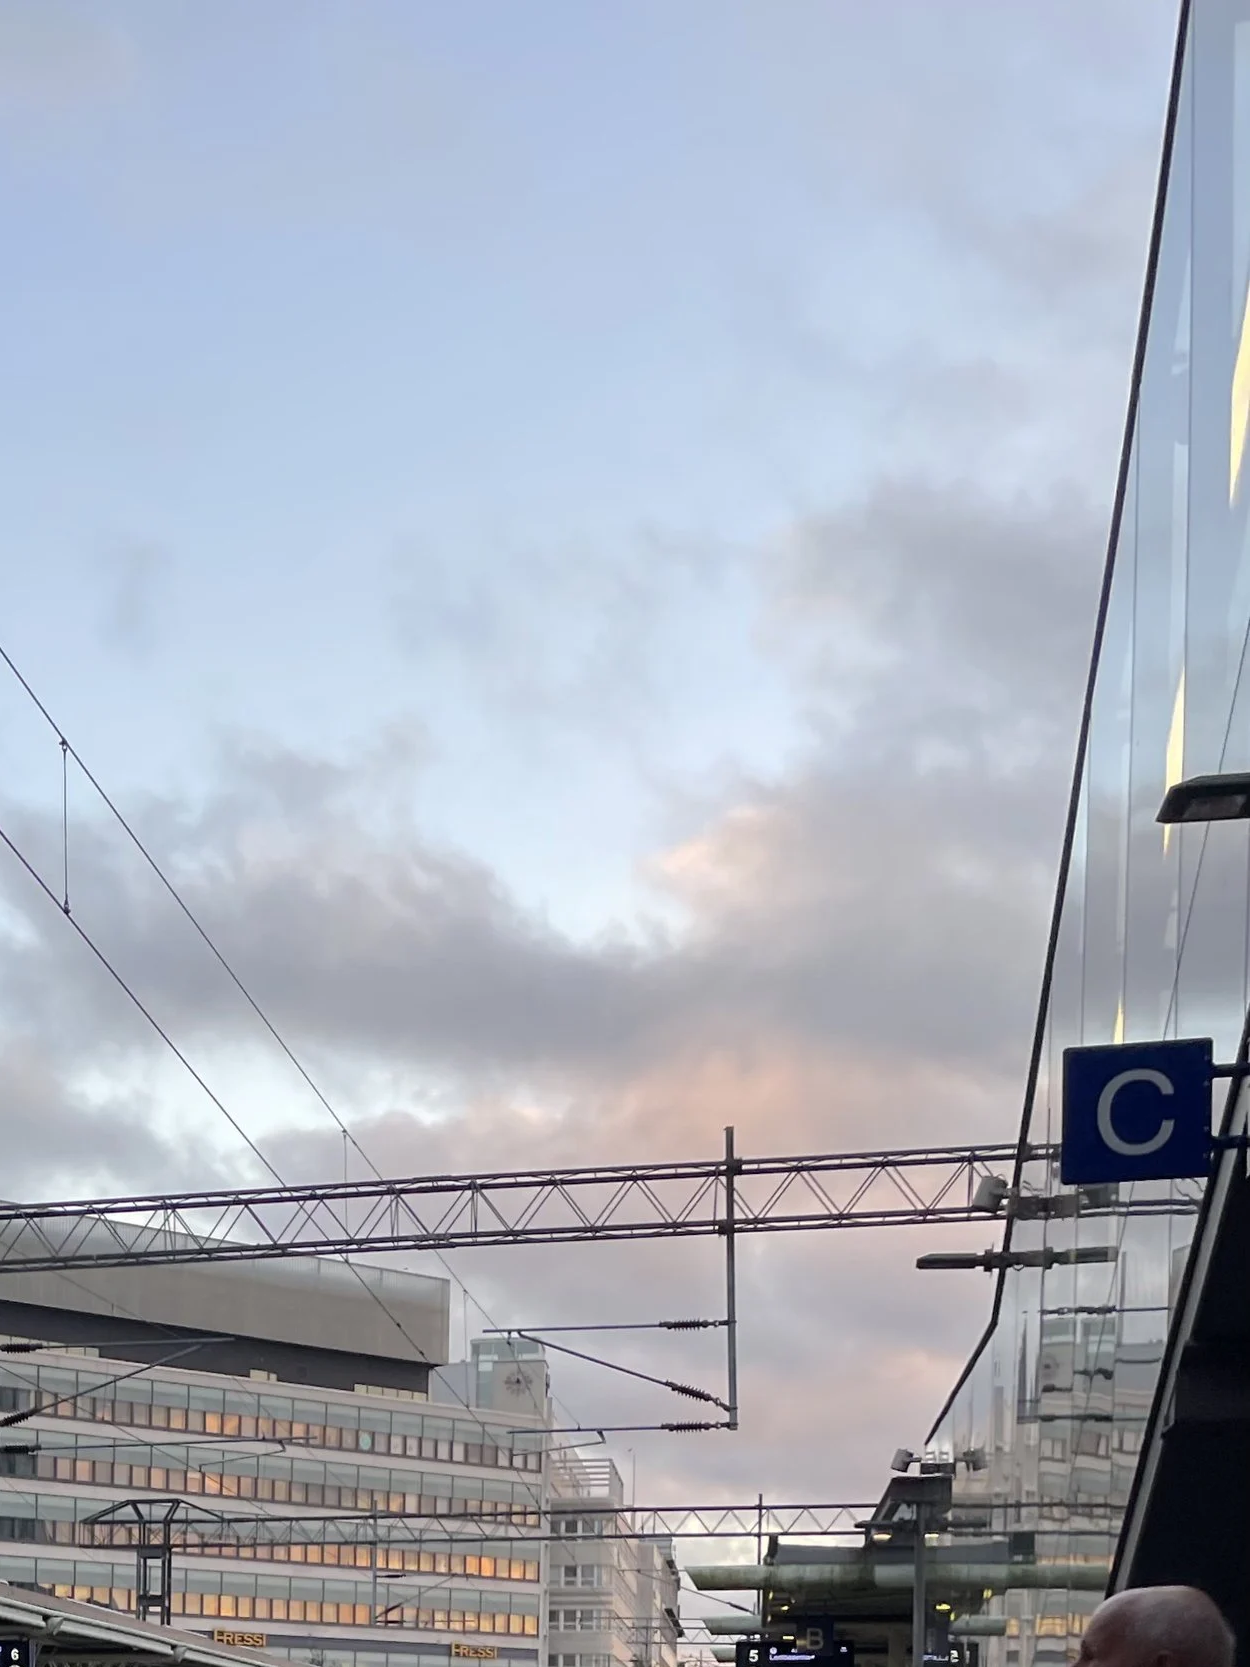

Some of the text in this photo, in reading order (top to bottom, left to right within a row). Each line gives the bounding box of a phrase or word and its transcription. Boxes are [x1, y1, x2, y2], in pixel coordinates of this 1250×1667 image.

[1097, 1068, 1175, 1156] C
[213, 1629, 267, 1648] FRESSI
[806, 1628, 824, 1650] B
[11, 1648, 19, 1661] 6
[451, 1641, 498, 1659] FRESSI
[749, 1650, 759, 1662] 5
